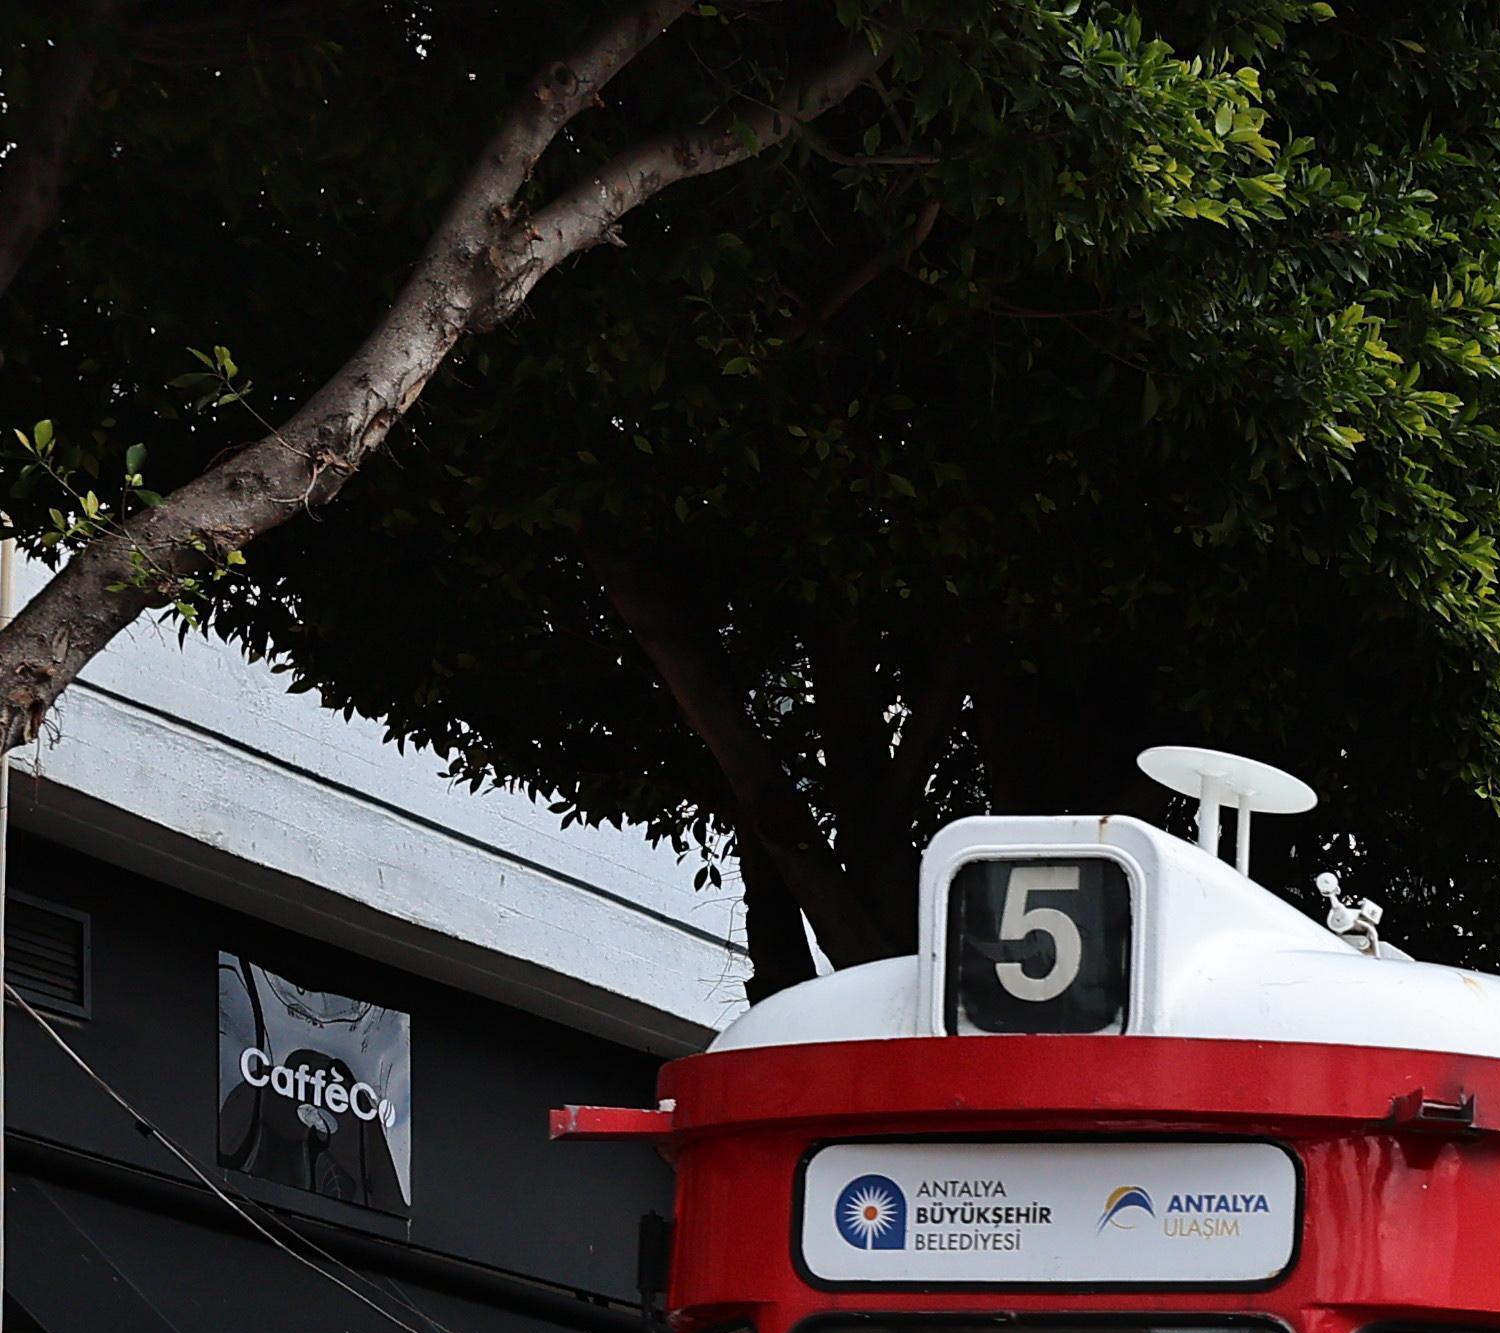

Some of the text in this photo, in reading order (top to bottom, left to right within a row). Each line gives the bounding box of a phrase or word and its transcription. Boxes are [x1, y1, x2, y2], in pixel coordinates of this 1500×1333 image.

[996, 867, 1081, 1001] 5
[240, 1047, 397, 1129] CaffèCo
[916, 1180, 1007, 1198] ANTALYA
[915, 1199, 1052, 1226] BÜYÜKŞEHİR
[1167, 1193, 1270, 1214] ANTALYA
[1163, 1217, 1240, 1238] ULAŞIM
[914, 1228, 1021, 1251] BELEDİYESİ
